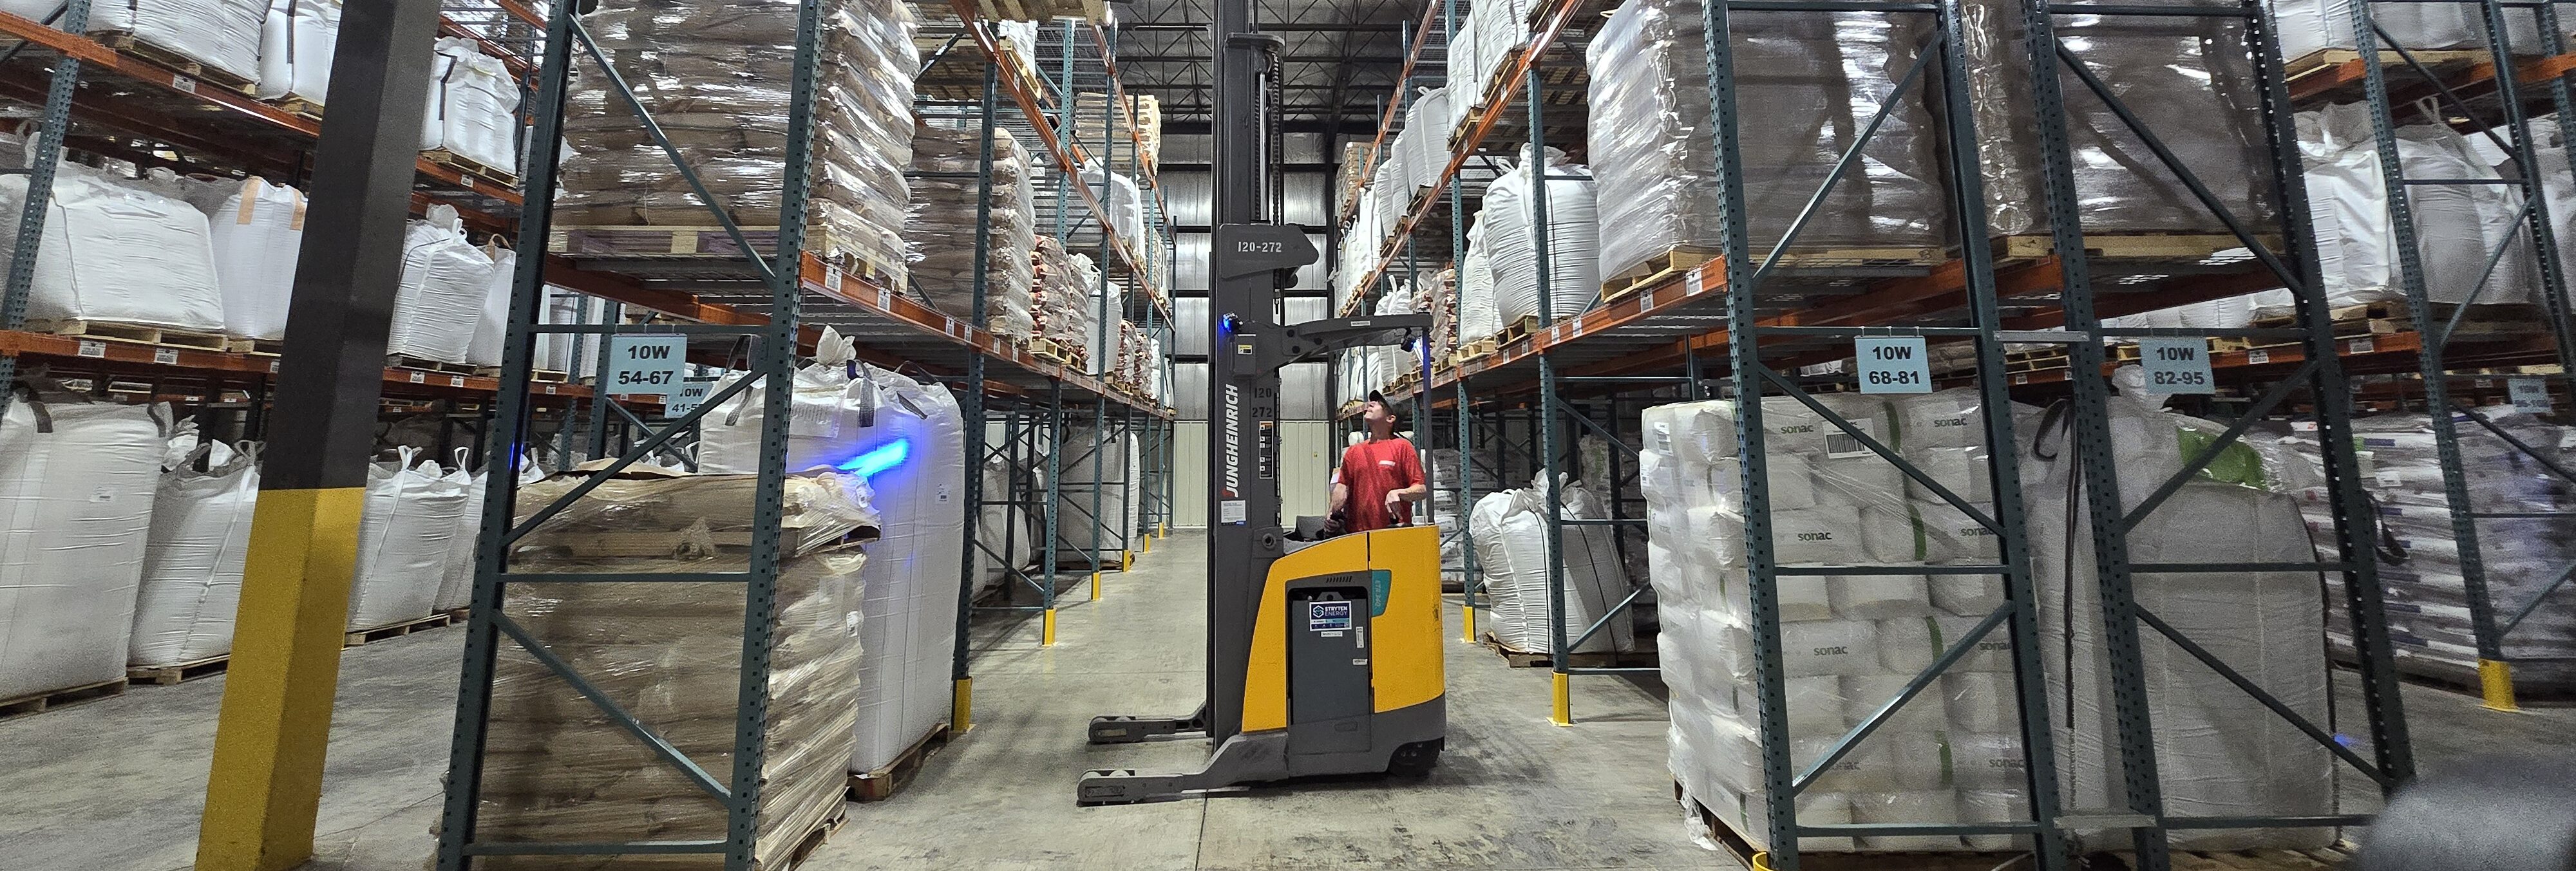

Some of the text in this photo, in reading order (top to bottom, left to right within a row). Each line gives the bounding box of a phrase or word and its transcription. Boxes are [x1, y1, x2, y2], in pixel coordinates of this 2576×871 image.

[1238, 241, 1282, 252] 120-272
[627, 345, 670, 359] 10W
[1872, 346, 1911, 360] 10W
[2156, 346, 2195, 361] 10W
[618, 370, 674, 385] 54-67
[1868, 371, 1920, 385] 68-81
[2154, 371, 2205, 385] 82-95
[1253, 388, 1273, 398] 120
[1252, 407, 1273, 418] 272
[1934, 417, 1968, 427] sonac
[1780, 424, 1814, 434] sonac
[1226, 384, 1239, 498] JUNGHEINRICH
[1797, 532, 1832, 541] sonac
[1813, 646, 1848, 656] sonac
